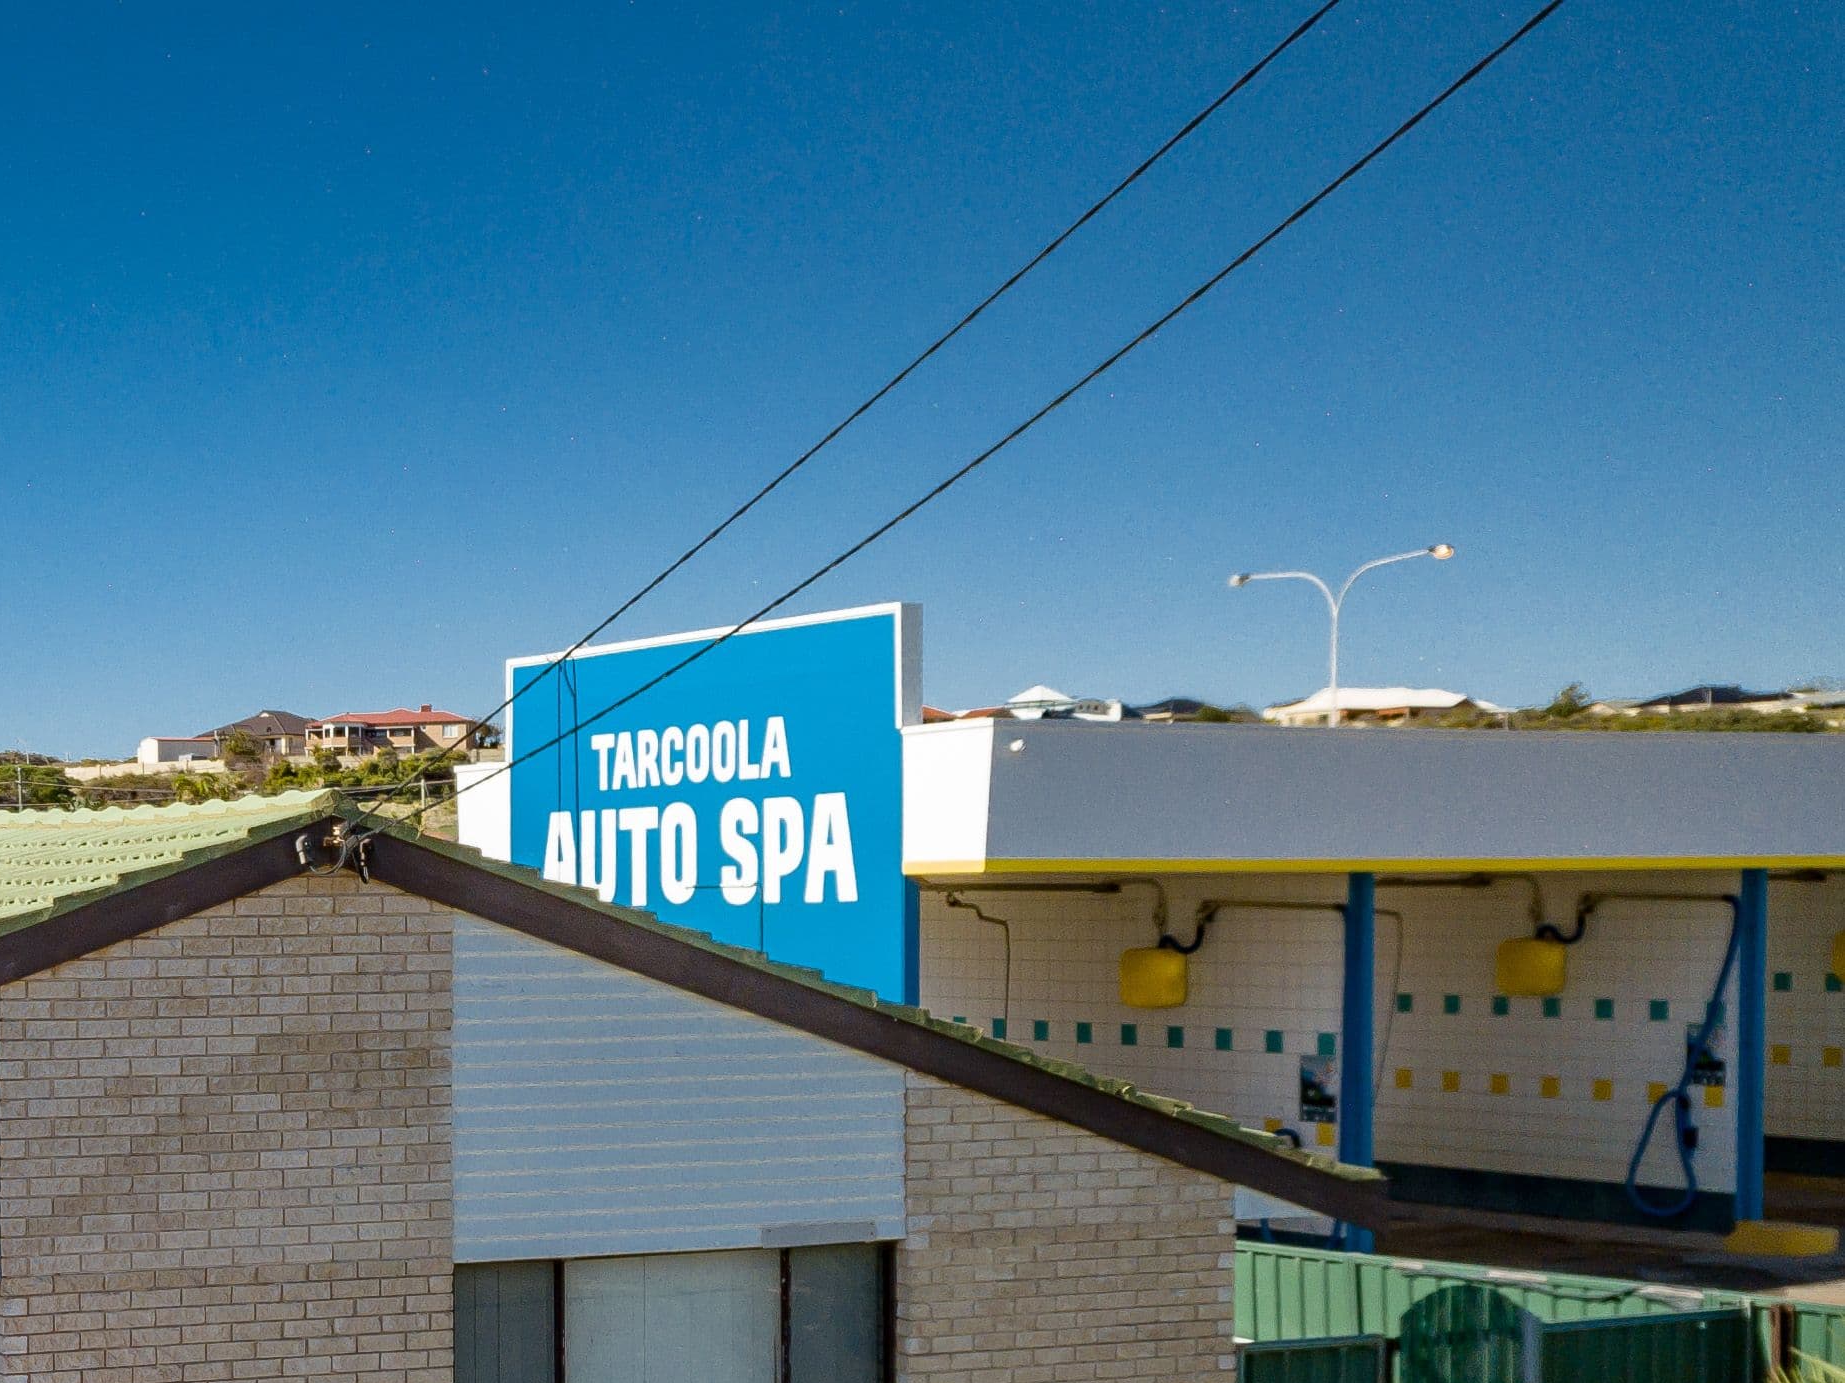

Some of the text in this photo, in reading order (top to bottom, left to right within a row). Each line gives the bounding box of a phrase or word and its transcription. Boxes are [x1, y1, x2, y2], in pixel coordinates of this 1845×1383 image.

[591, 716, 792, 791] TARCOOLA
[542, 791, 859, 907] AUTO SPA
